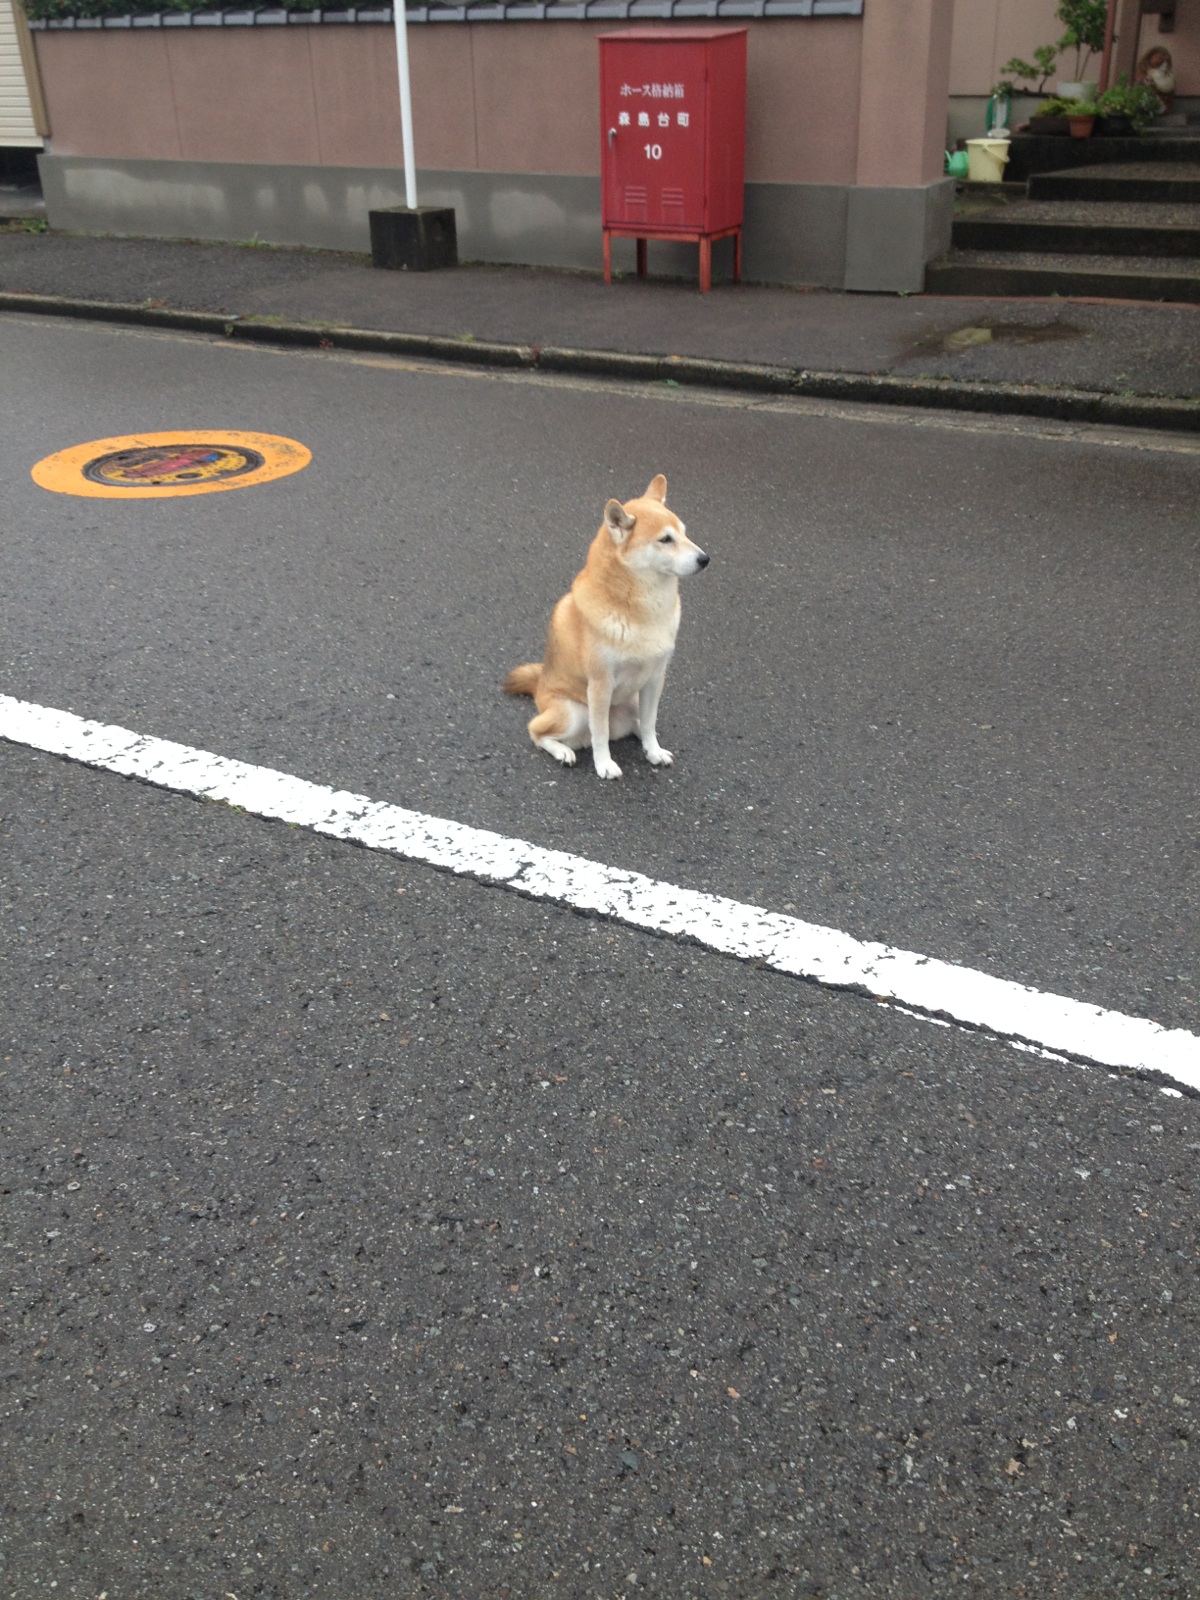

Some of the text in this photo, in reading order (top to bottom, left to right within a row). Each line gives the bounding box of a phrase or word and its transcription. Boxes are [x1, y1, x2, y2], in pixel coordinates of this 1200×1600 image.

[620, 83, 684, 98] ホース格納箱
[644, 144, 662, 160] 10
